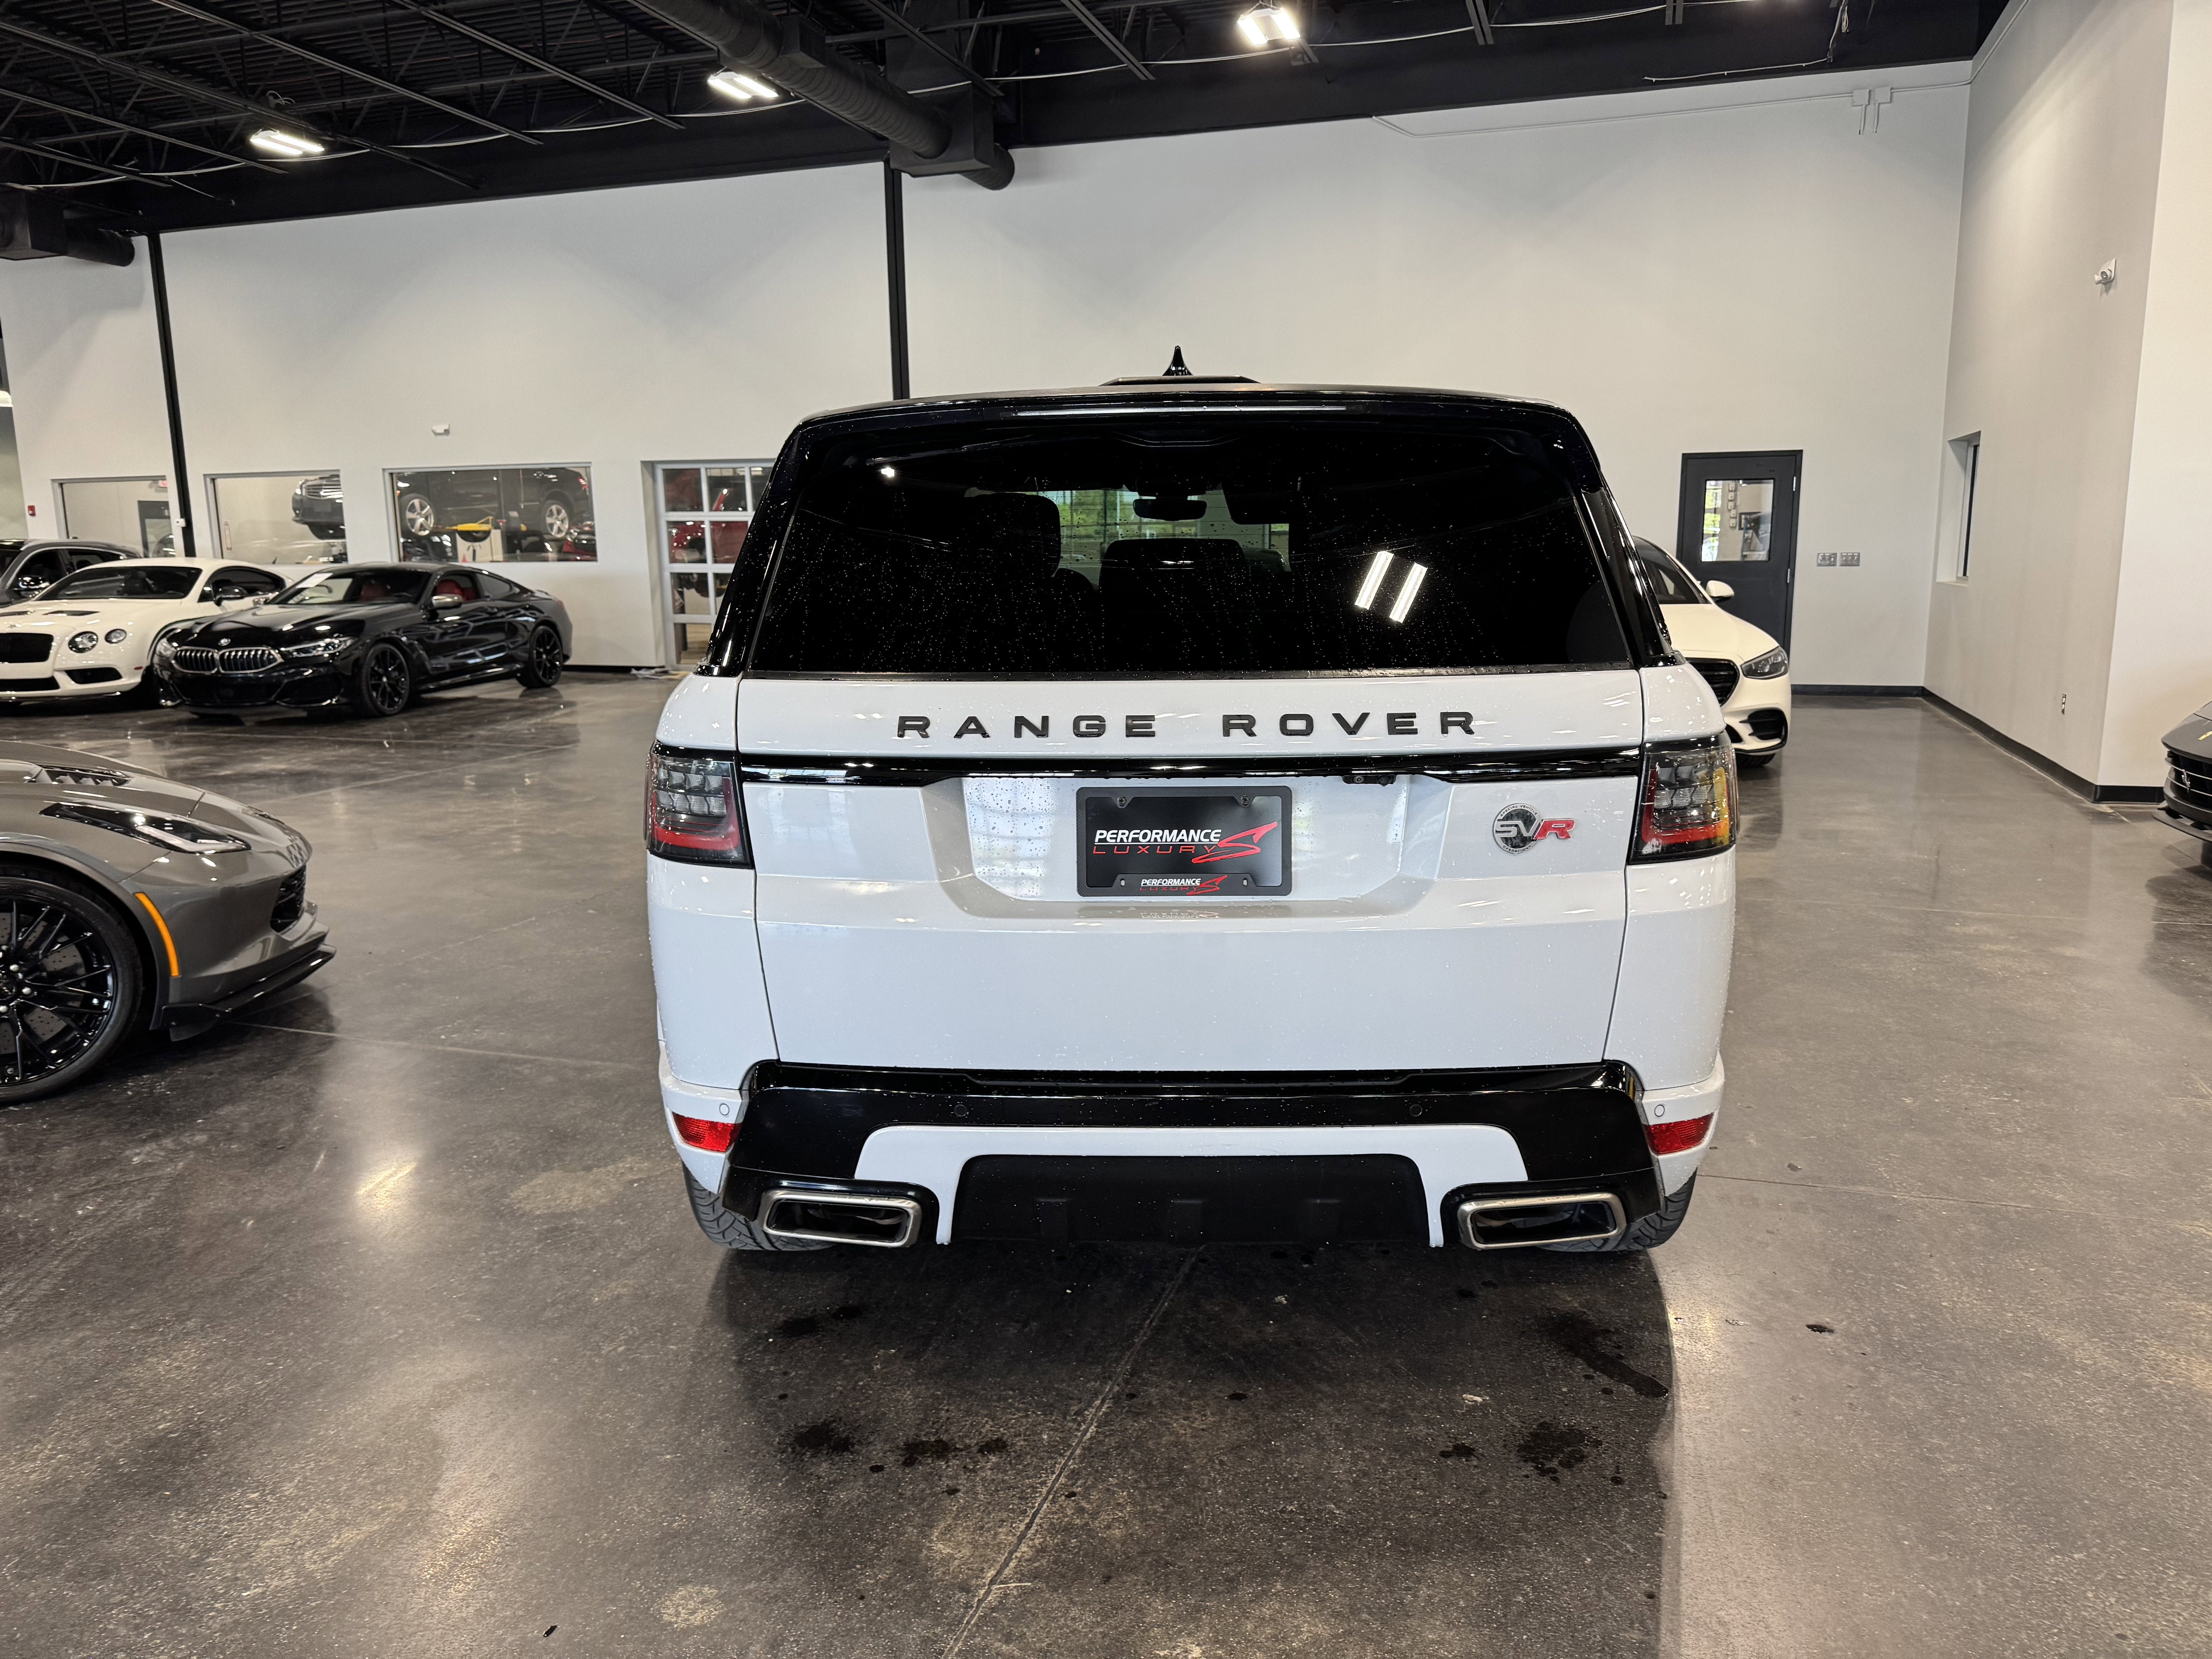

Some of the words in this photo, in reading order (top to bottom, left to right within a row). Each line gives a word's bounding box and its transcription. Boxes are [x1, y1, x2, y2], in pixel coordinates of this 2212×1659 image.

[897, 715, 1156, 738] RANGE
[1222, 712, 1475, 737] ROVER
[1500, 805, 1518, 817] SPECIAL
[1520, 804, 1538, 816] VEHICLE
[1094, 829, 1222, 843] PERFORMANCE
[1093, 845, 1216, 854] LUXURY
